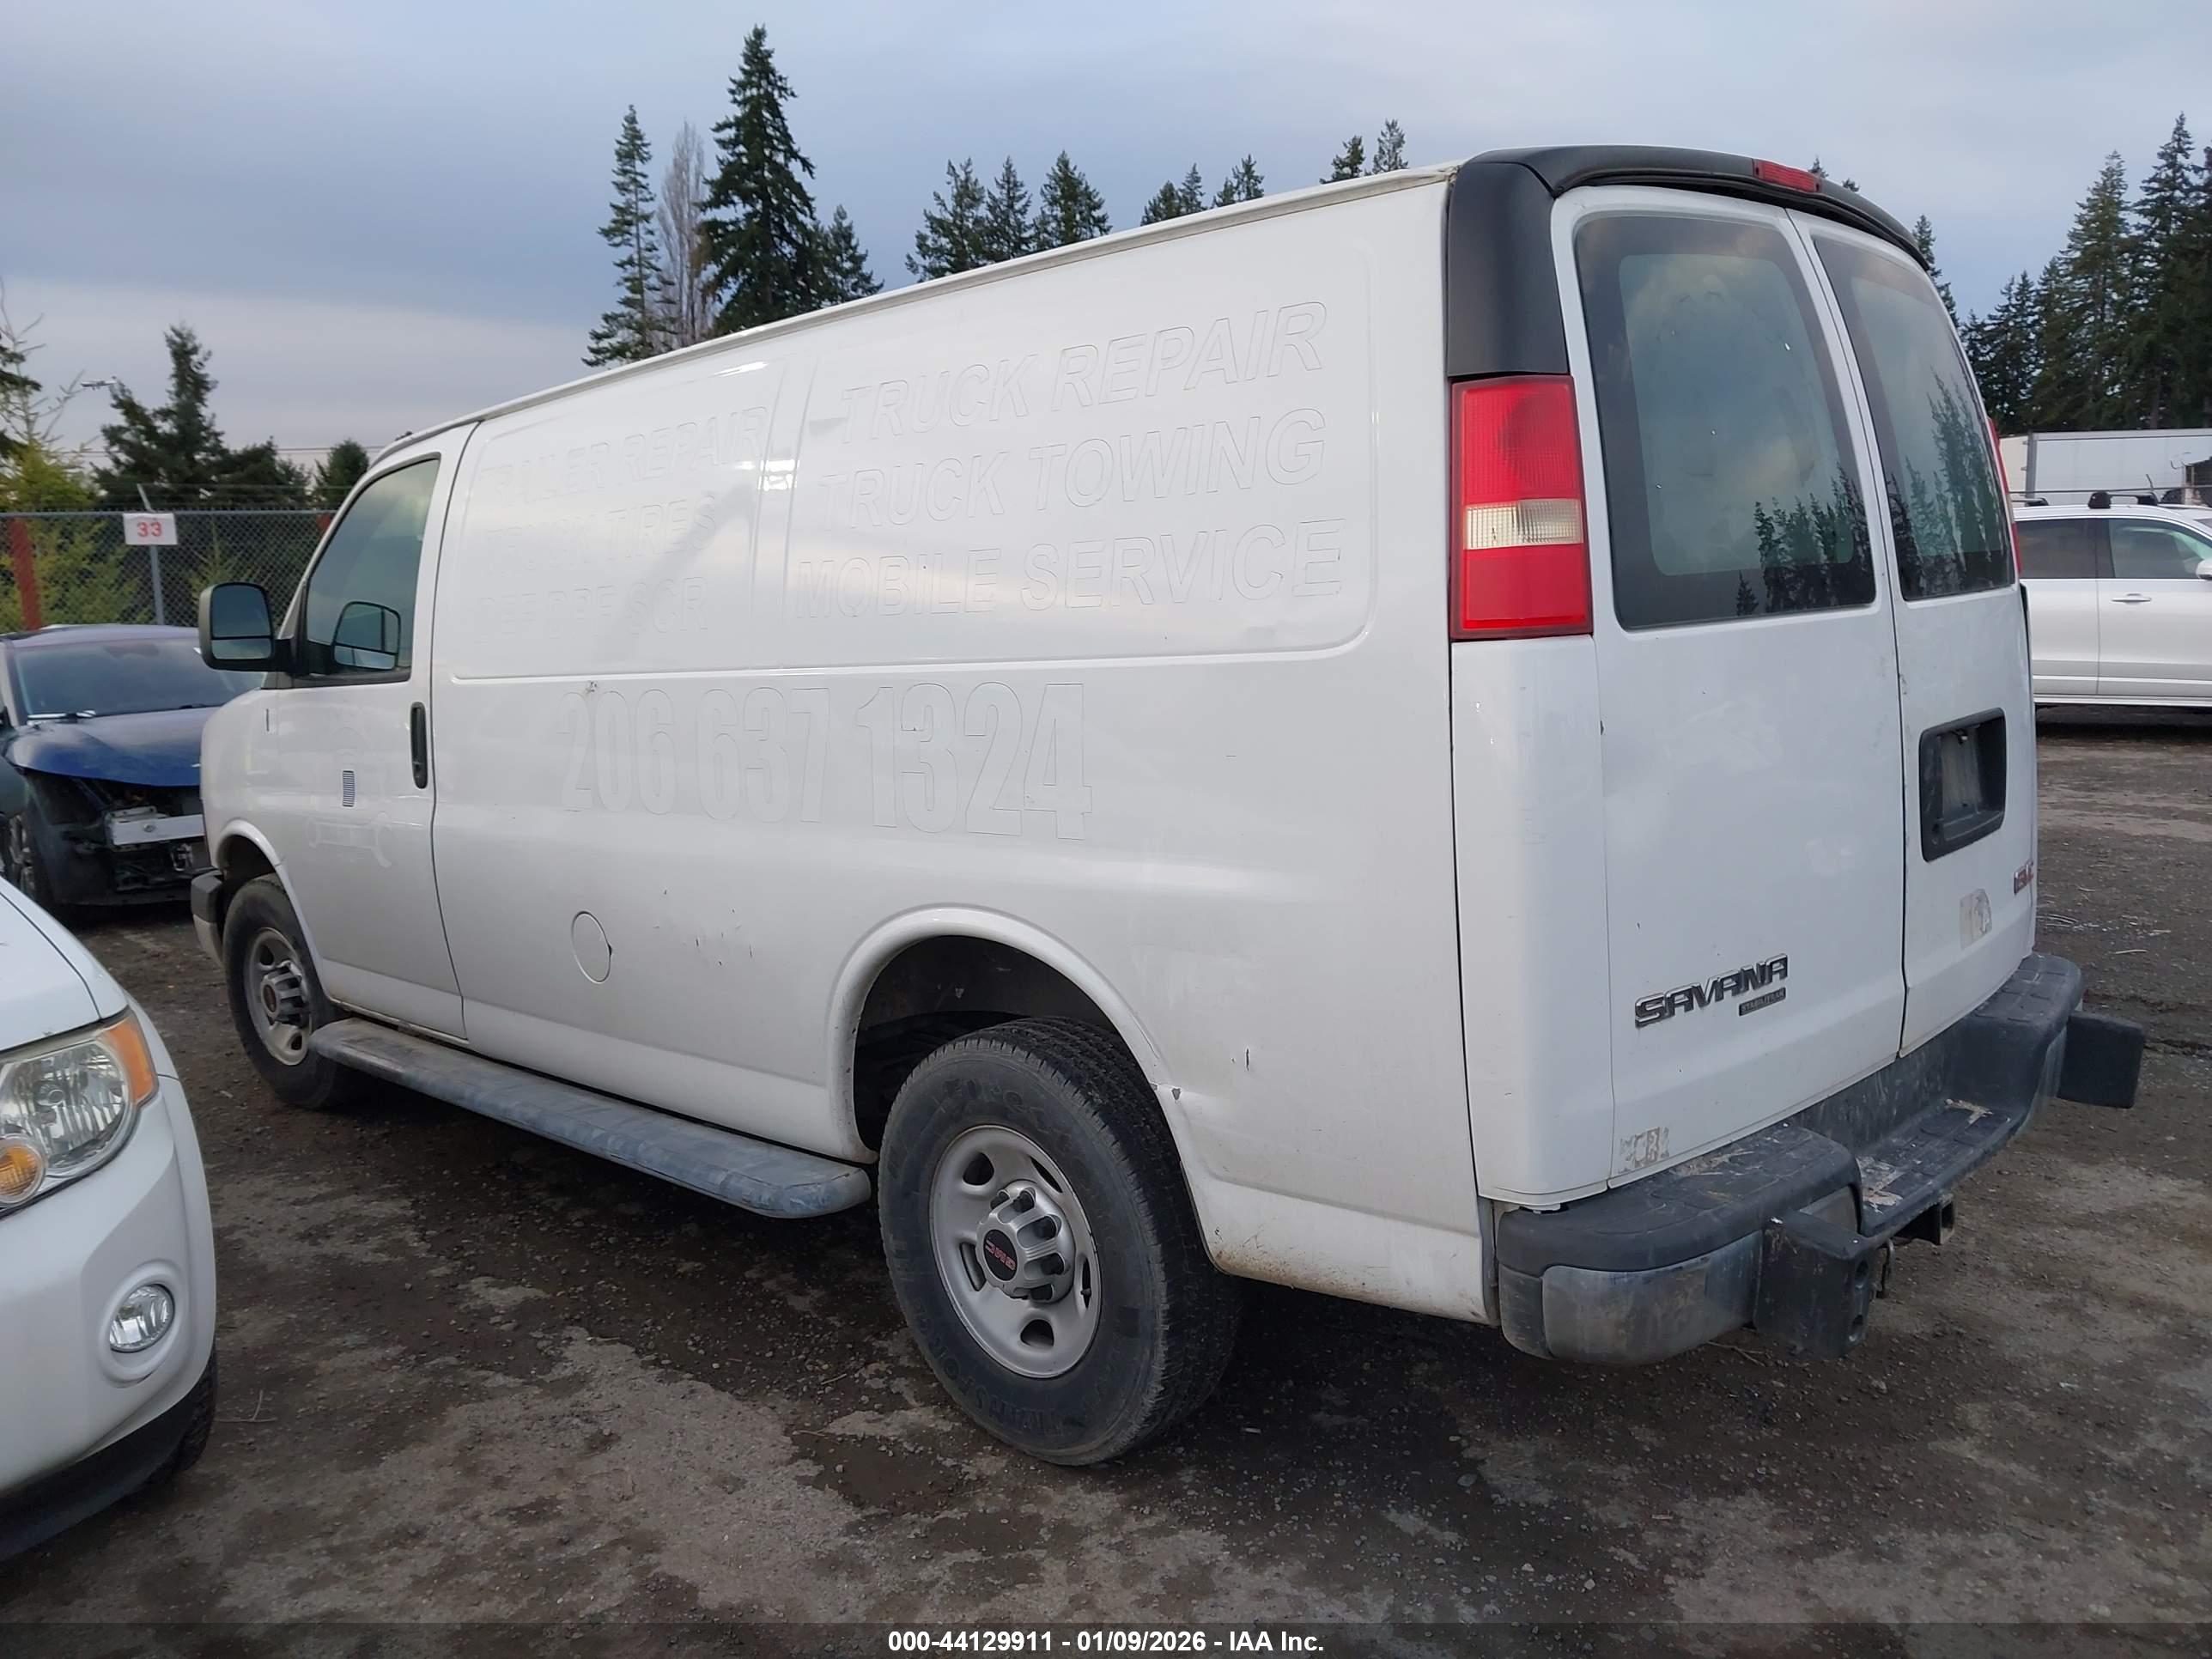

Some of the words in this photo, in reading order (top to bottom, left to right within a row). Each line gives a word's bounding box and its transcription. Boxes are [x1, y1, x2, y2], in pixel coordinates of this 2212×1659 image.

[841, 352, 1039, 444] TRUCK
[1051, 300, 1328, 413] REPAIR
[618, 405, 768, 485] REPAIR
[817, 449, 1011, 532] TRUCK
[1028, 406, 1327, 512] TOWING
[137, 520, 161, 537] 33
[605, 493, 717, 561] TIRES
[628, 575, 708, 639] SCR
[797, 544, 1002, 620] MOBILE
[1018, 516, 1347, 613] SERVICE
[556, 690, 676, 815] 206
[696, 687, 831, 823] 637
[856, 681, 1093, 842] 1324
[1635, 953, 1788, 1029] SAVANA
[985, 1238, 1016, 1271] GMC
